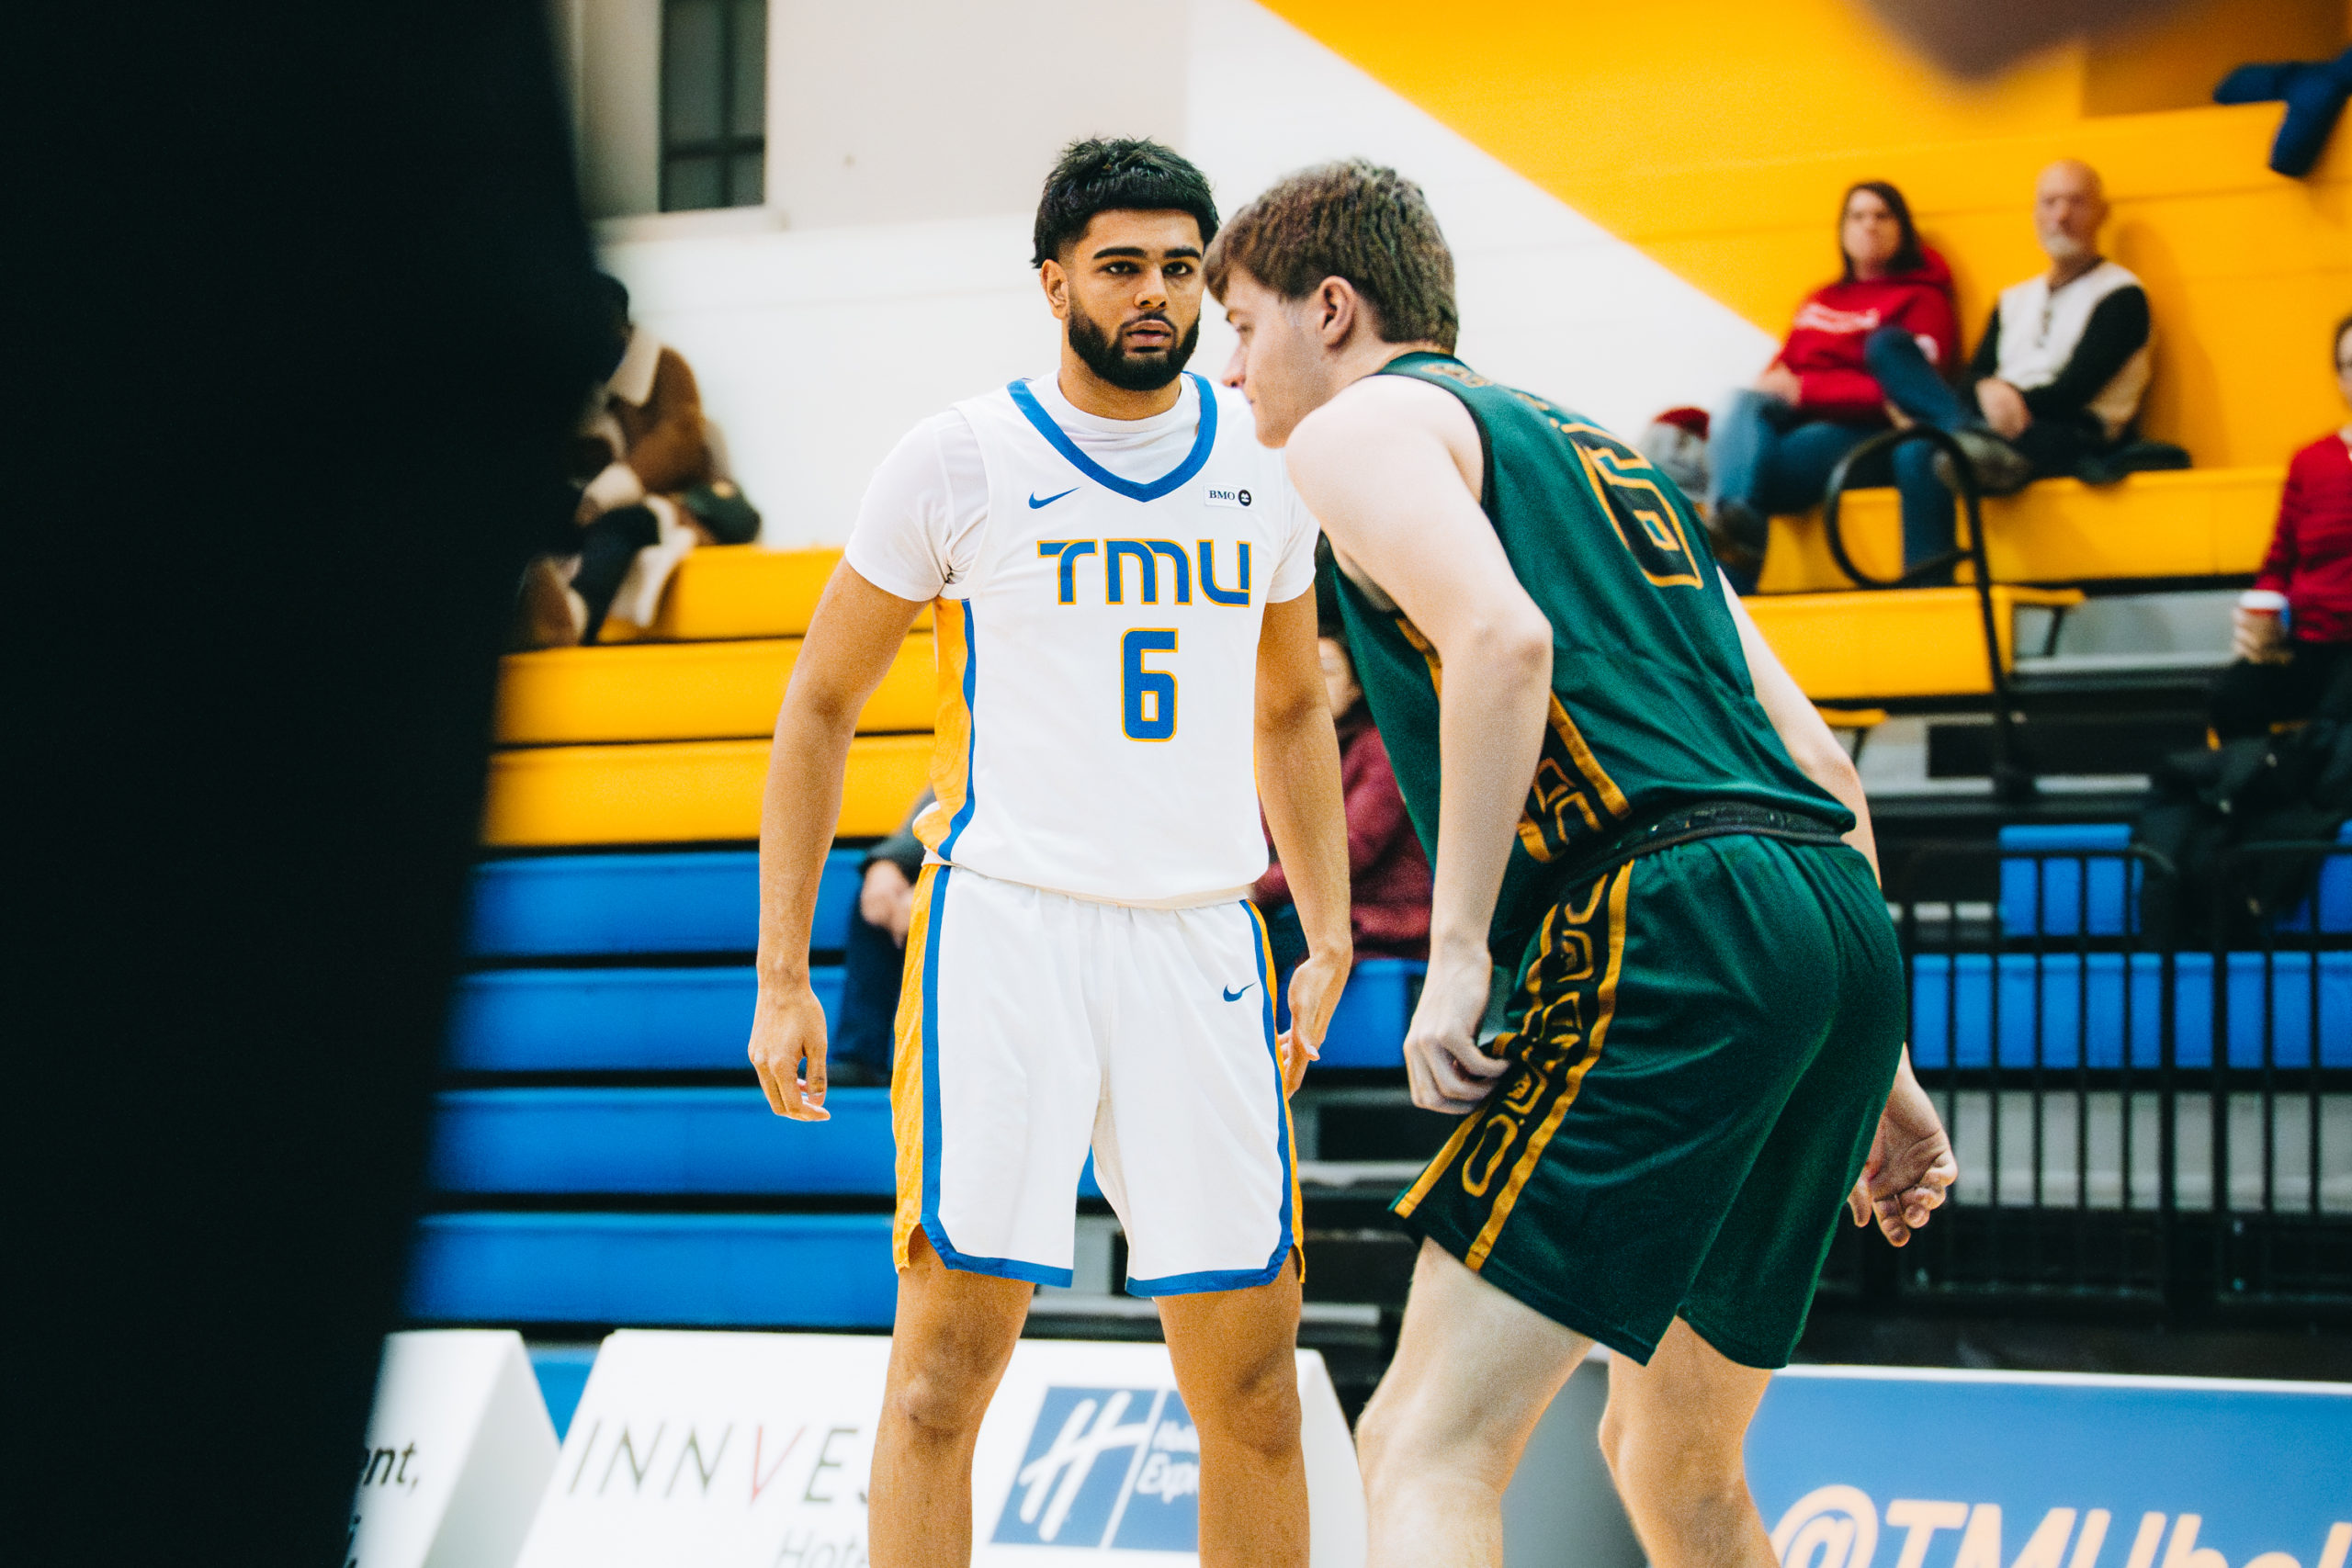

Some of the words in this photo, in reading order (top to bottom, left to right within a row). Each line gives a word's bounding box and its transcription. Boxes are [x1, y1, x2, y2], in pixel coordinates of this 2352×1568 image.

[1208, 490, 1236, 501] BMO
[1560, 423, 1703, 590] 6
[1037, 538, 1251, 608] TMU
[1120, 627, 1179, 742] 6
[567, 1419, 868, 1505] INNVE
